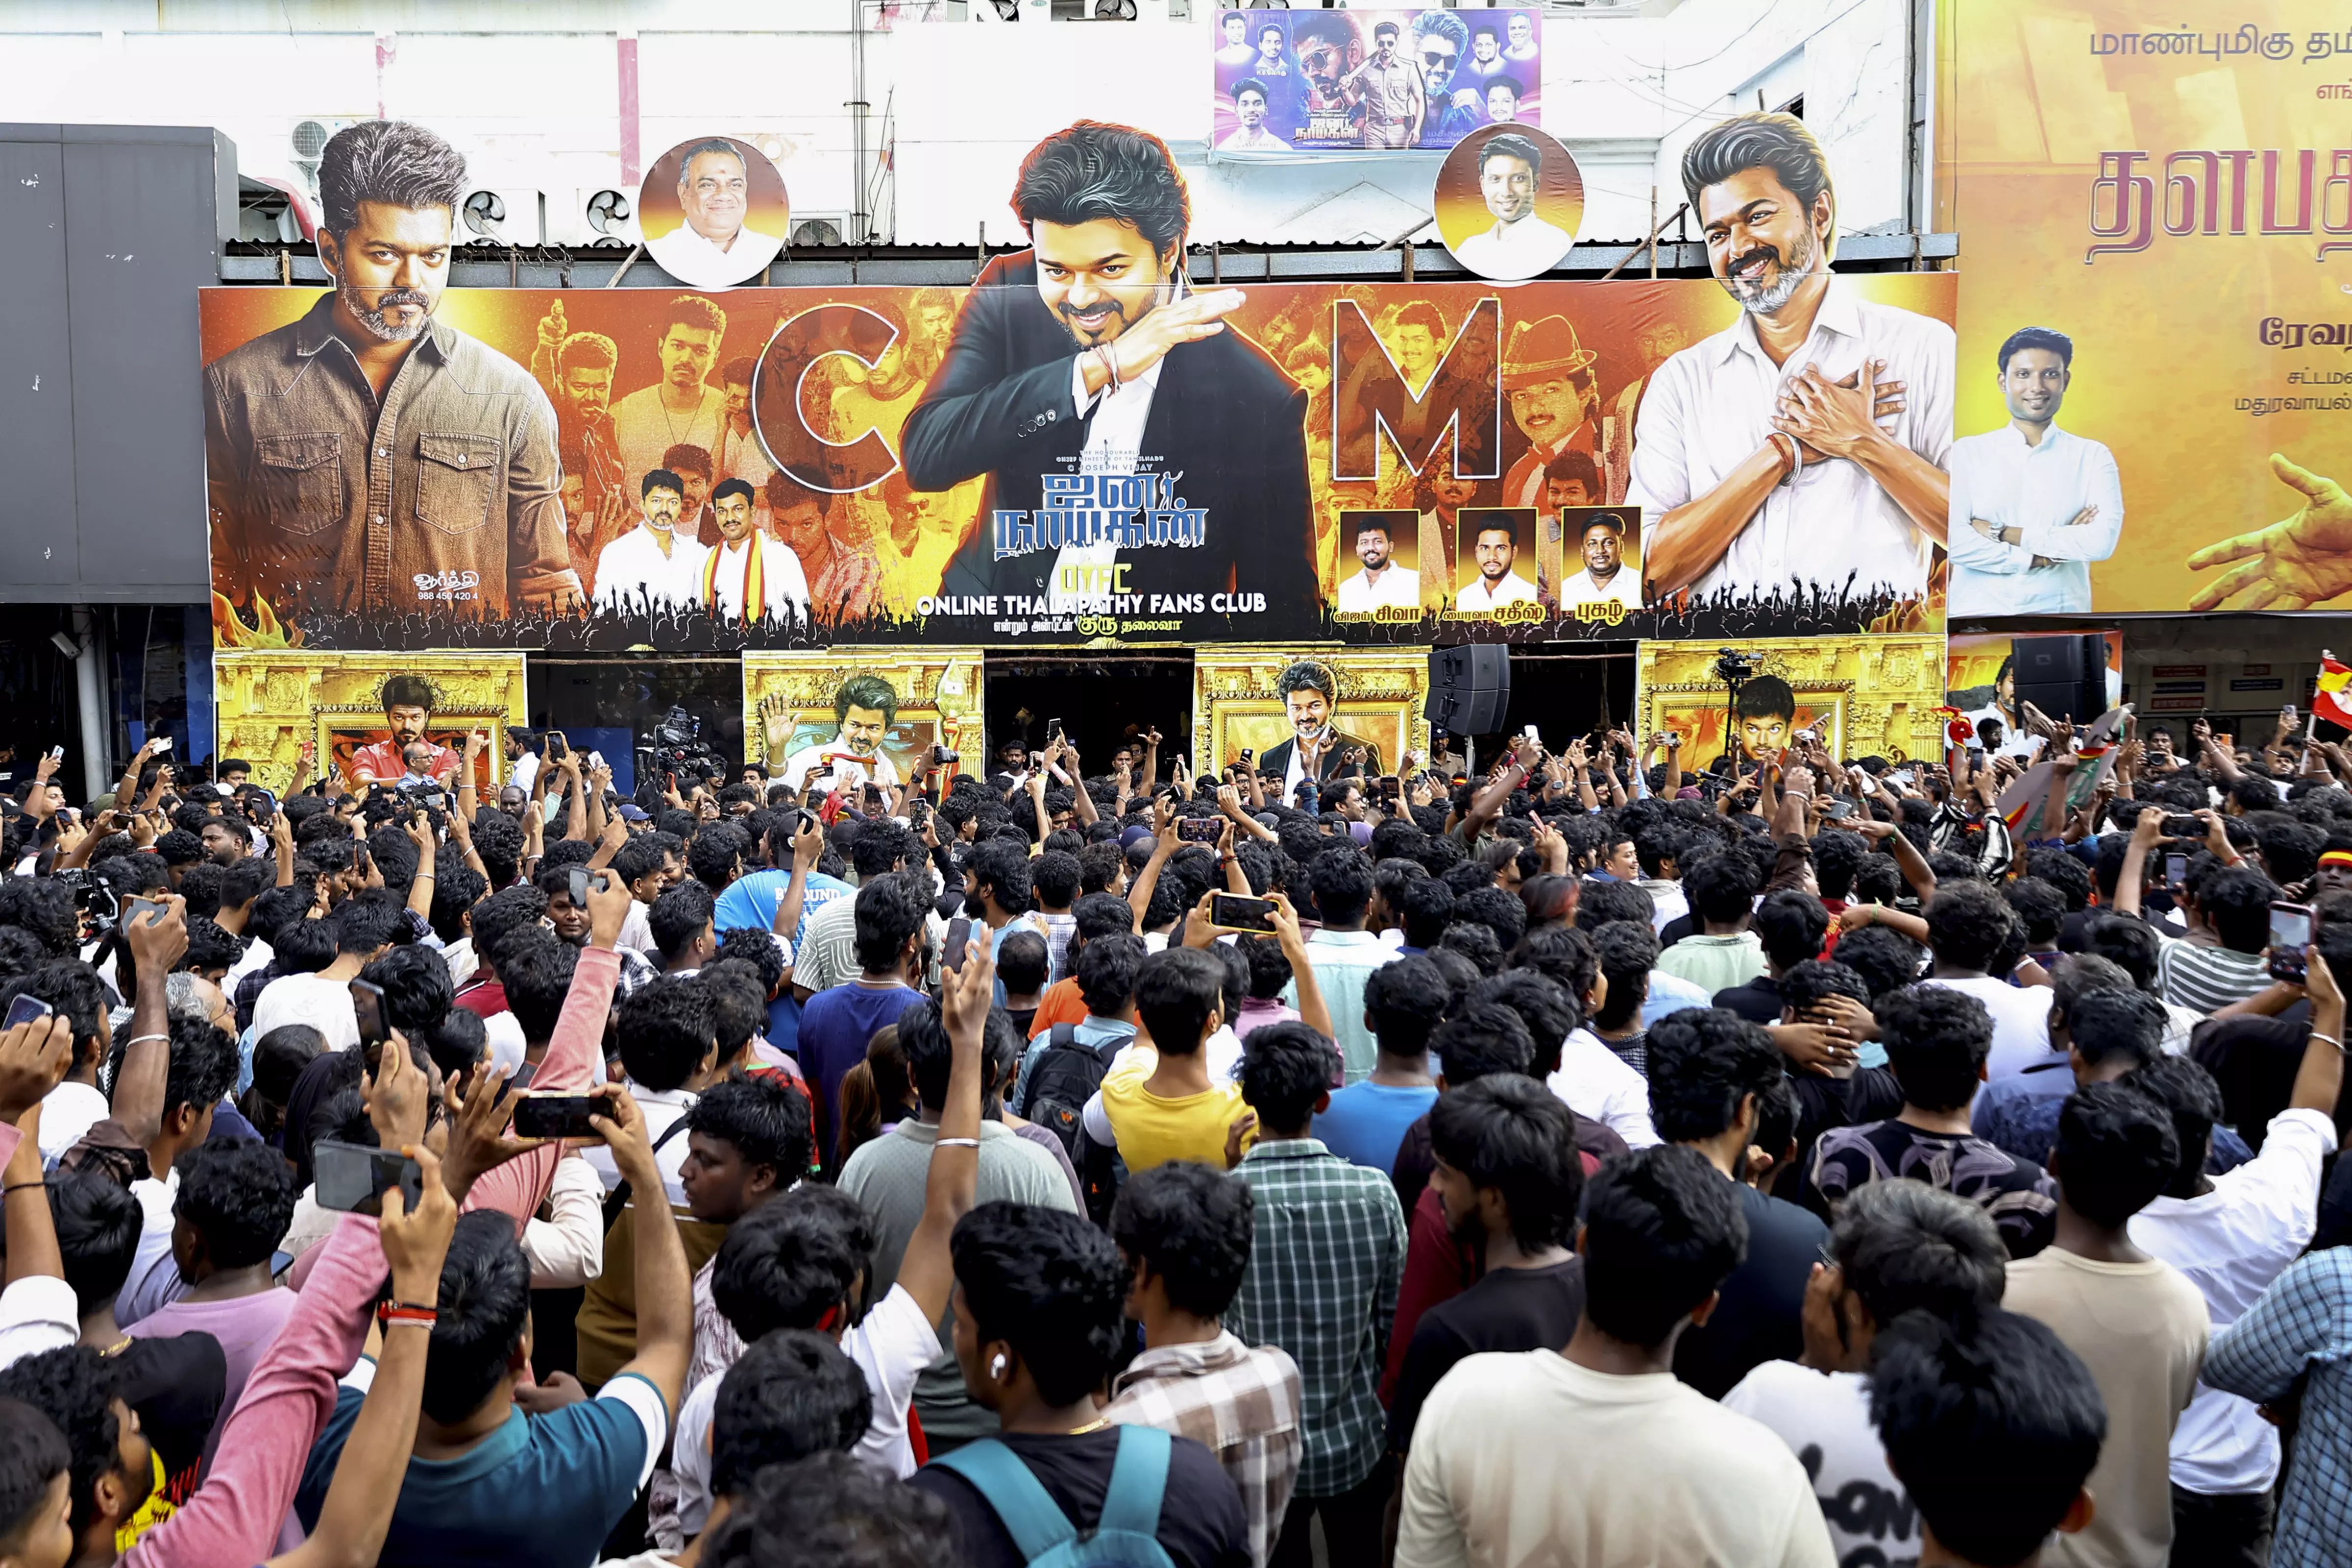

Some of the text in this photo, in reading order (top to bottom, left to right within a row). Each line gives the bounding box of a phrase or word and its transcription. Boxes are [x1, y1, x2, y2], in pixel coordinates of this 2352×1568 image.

[2090, 23, 2294, 61] மாண்புமிகு
[752, 297, 1502, 493] C M
[417, 592, 478, 600] 988 450 420 4
[916, 593, 1267, 616] ONLINE THALAPATHY FANS CLUB
[1375, 605, 1421, 622] சிவா
[1494, 599, 1545, 624] சதீஷ்
[1576, 600, 1624, 624] புகழ்
[993, 615, 1182, 636] என்றும் அன்புடன் குரு தலைவா
